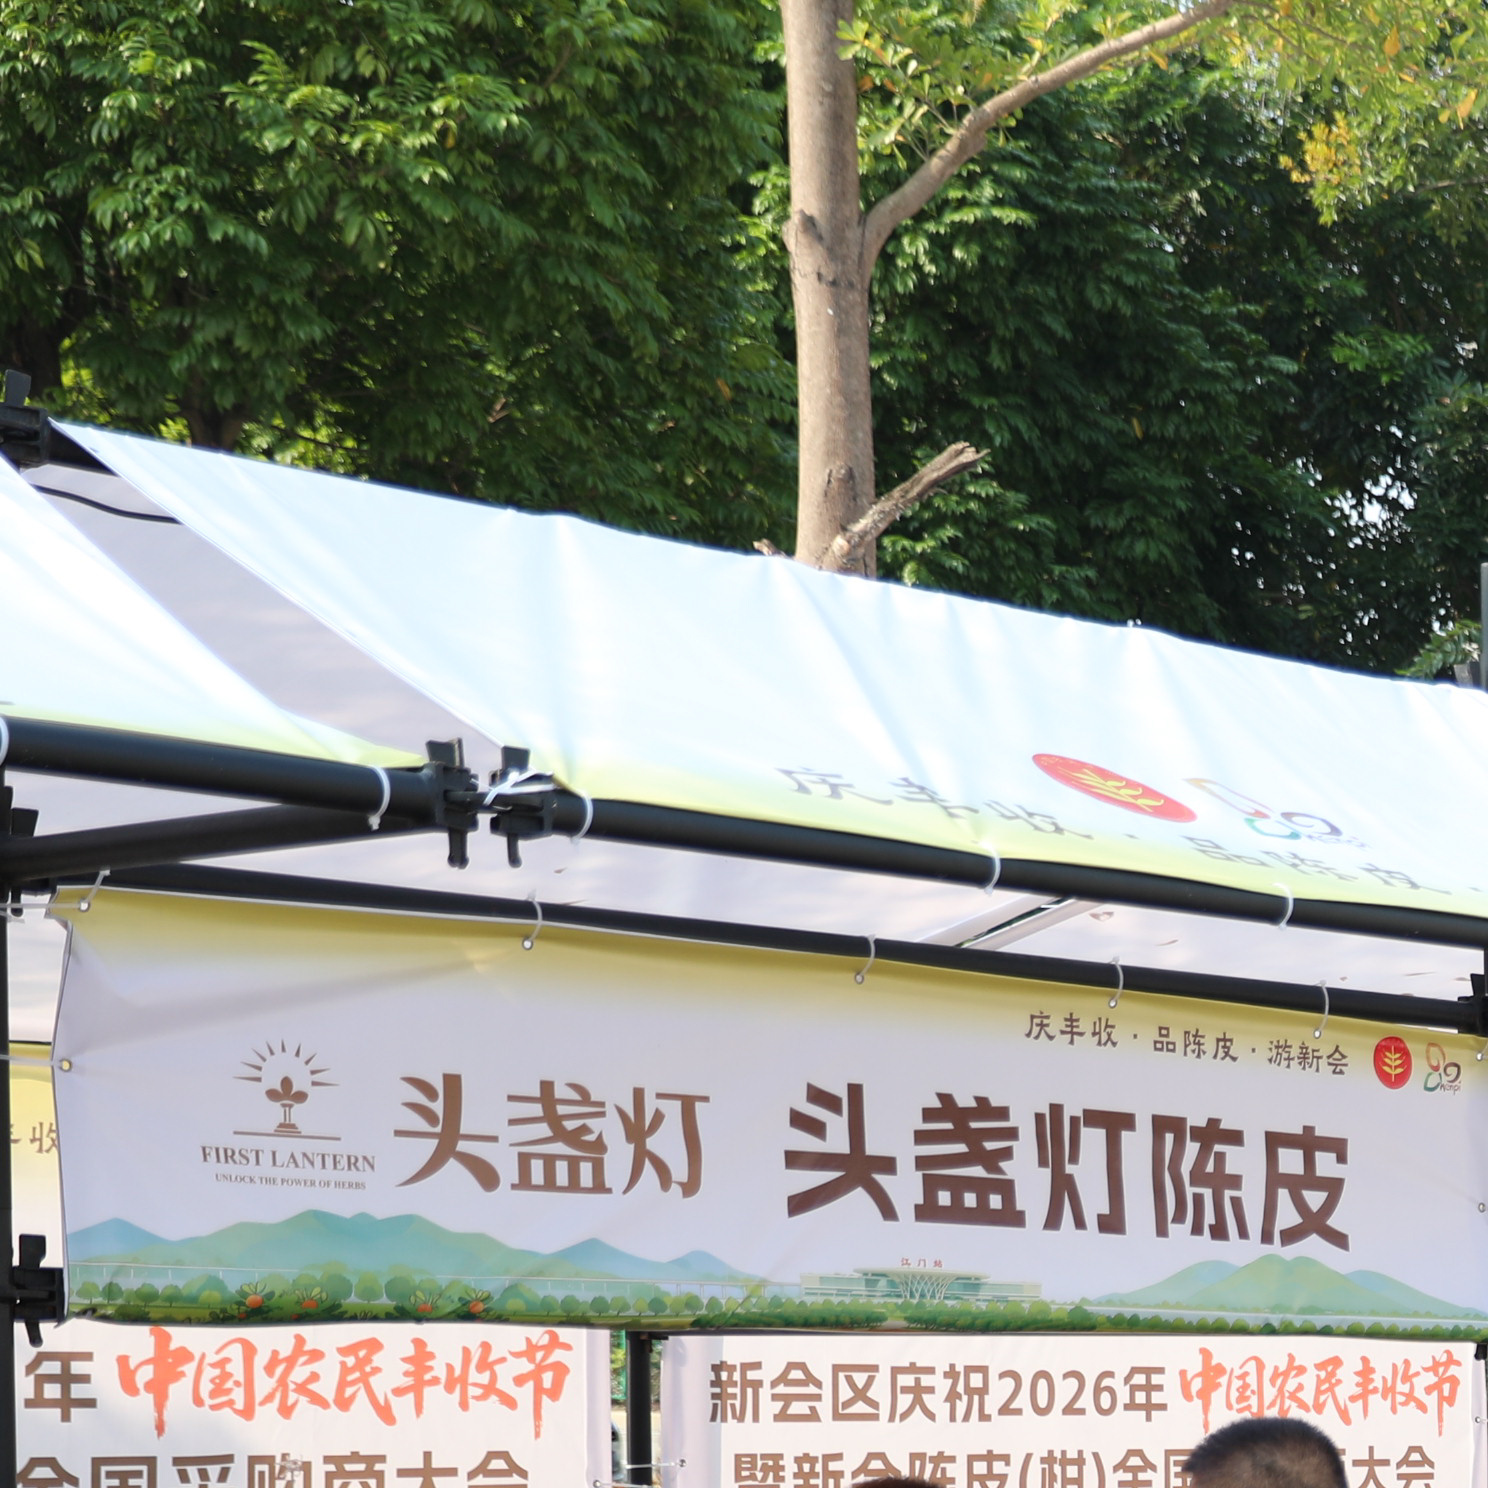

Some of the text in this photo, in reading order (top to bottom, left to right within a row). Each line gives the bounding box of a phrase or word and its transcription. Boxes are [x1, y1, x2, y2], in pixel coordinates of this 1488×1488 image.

[200, 1145, 376, 1172] FIRST LANTERN
[216, 1173, 367, 1190] UNLOCK THE POWER OF HERBS
[394, 1073, 711, 1199] 头盏灯
[784, 1081, 1351, 1252] 头盏灯陈皮
[23, 1326, 573, 1440] 年 中国农民丰收节
[709, 1348, 1463, 1437] 新会区庆祝2026年 中国农民丰收节
